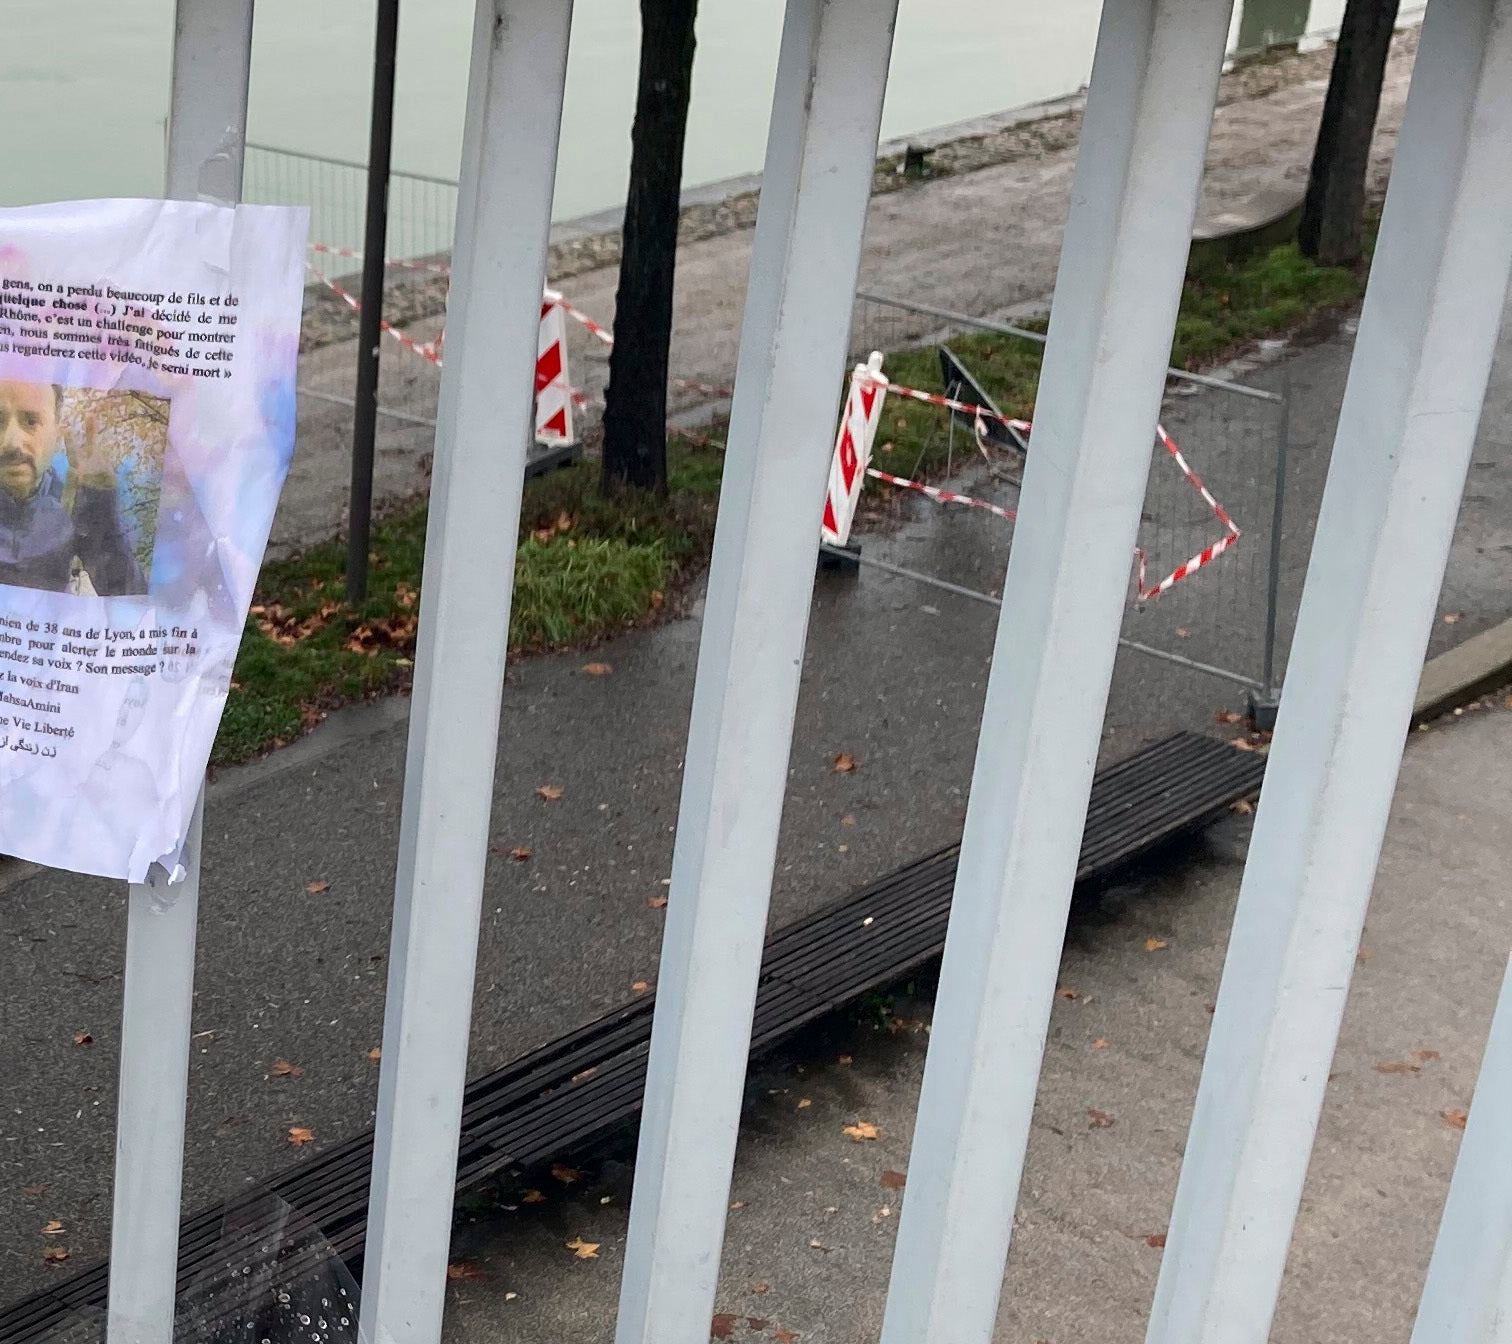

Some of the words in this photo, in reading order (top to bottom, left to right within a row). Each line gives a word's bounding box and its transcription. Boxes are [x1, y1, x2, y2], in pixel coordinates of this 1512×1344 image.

[2, 279, 33, 291] gens,
[38, 282, 52, 292] on
[57, 285, 63, 293] a
[68, 284, 102, 297] perdu
[107, 286, 164, 305] beaucoup
[168, 292, 182, 304] de
[187, 292, 205, 305] fils
[210, 295, 220, 306] et
[224, 293, 239, 306] de
[52, 298, 88, 311] chose
[151, 310, 191, 323] décidé
[197, 312, 212, 324] de
[218, 315, 237, 325] me
[77, 318, 92, 328] un
[96, 318, 153, 336] challenge
[156, 329, 186, 340] pour
[188, 331, 236, 343] montrer
[20, 327, 48, 338] nous
[53, 331, 102, 344] sommes
[108, 335, 130, 346] très
[134, 339, 180, 357] fatigués
[185, 347, 200, 359] de
[204, 349, 234, 361] cette
[12, 342, 75, 359] regarderez
[78, 349, 107, 361] cette
[147, 358, 159, 370] je
[161, 363, 189, 375] serai
[192, 367, 220, 378] mort
[26, 620, 39, 631] de
[44, 622, 58, 634] 38
[62, 627, 81, 637] ans
[86, 628, 100, 639] de
[105, 627, 135, 642] Lyon,
[149, 626, 167, 638] mis
[172, 627, 187, 638] fin
[28, 639, 55, 650] pour
[62, 642, 98, 657] alerter
[105, 646, 115, 657] le
[122, 644, 157, 656] monde
[163, 646, 179, 655] sur
[186, 643, 195, 654] la
[32, 657, 44, 666] sa
[48, 657, 72, 670] voix
[85, 662, 108, 674] Son
[111, 664, 156, 676] message
[8, 671, 17, 682] la
[20, 677, 42, 688] voix
[12, 716, 31, 730] Vie
[34, 722, 75, 739] Liberté
